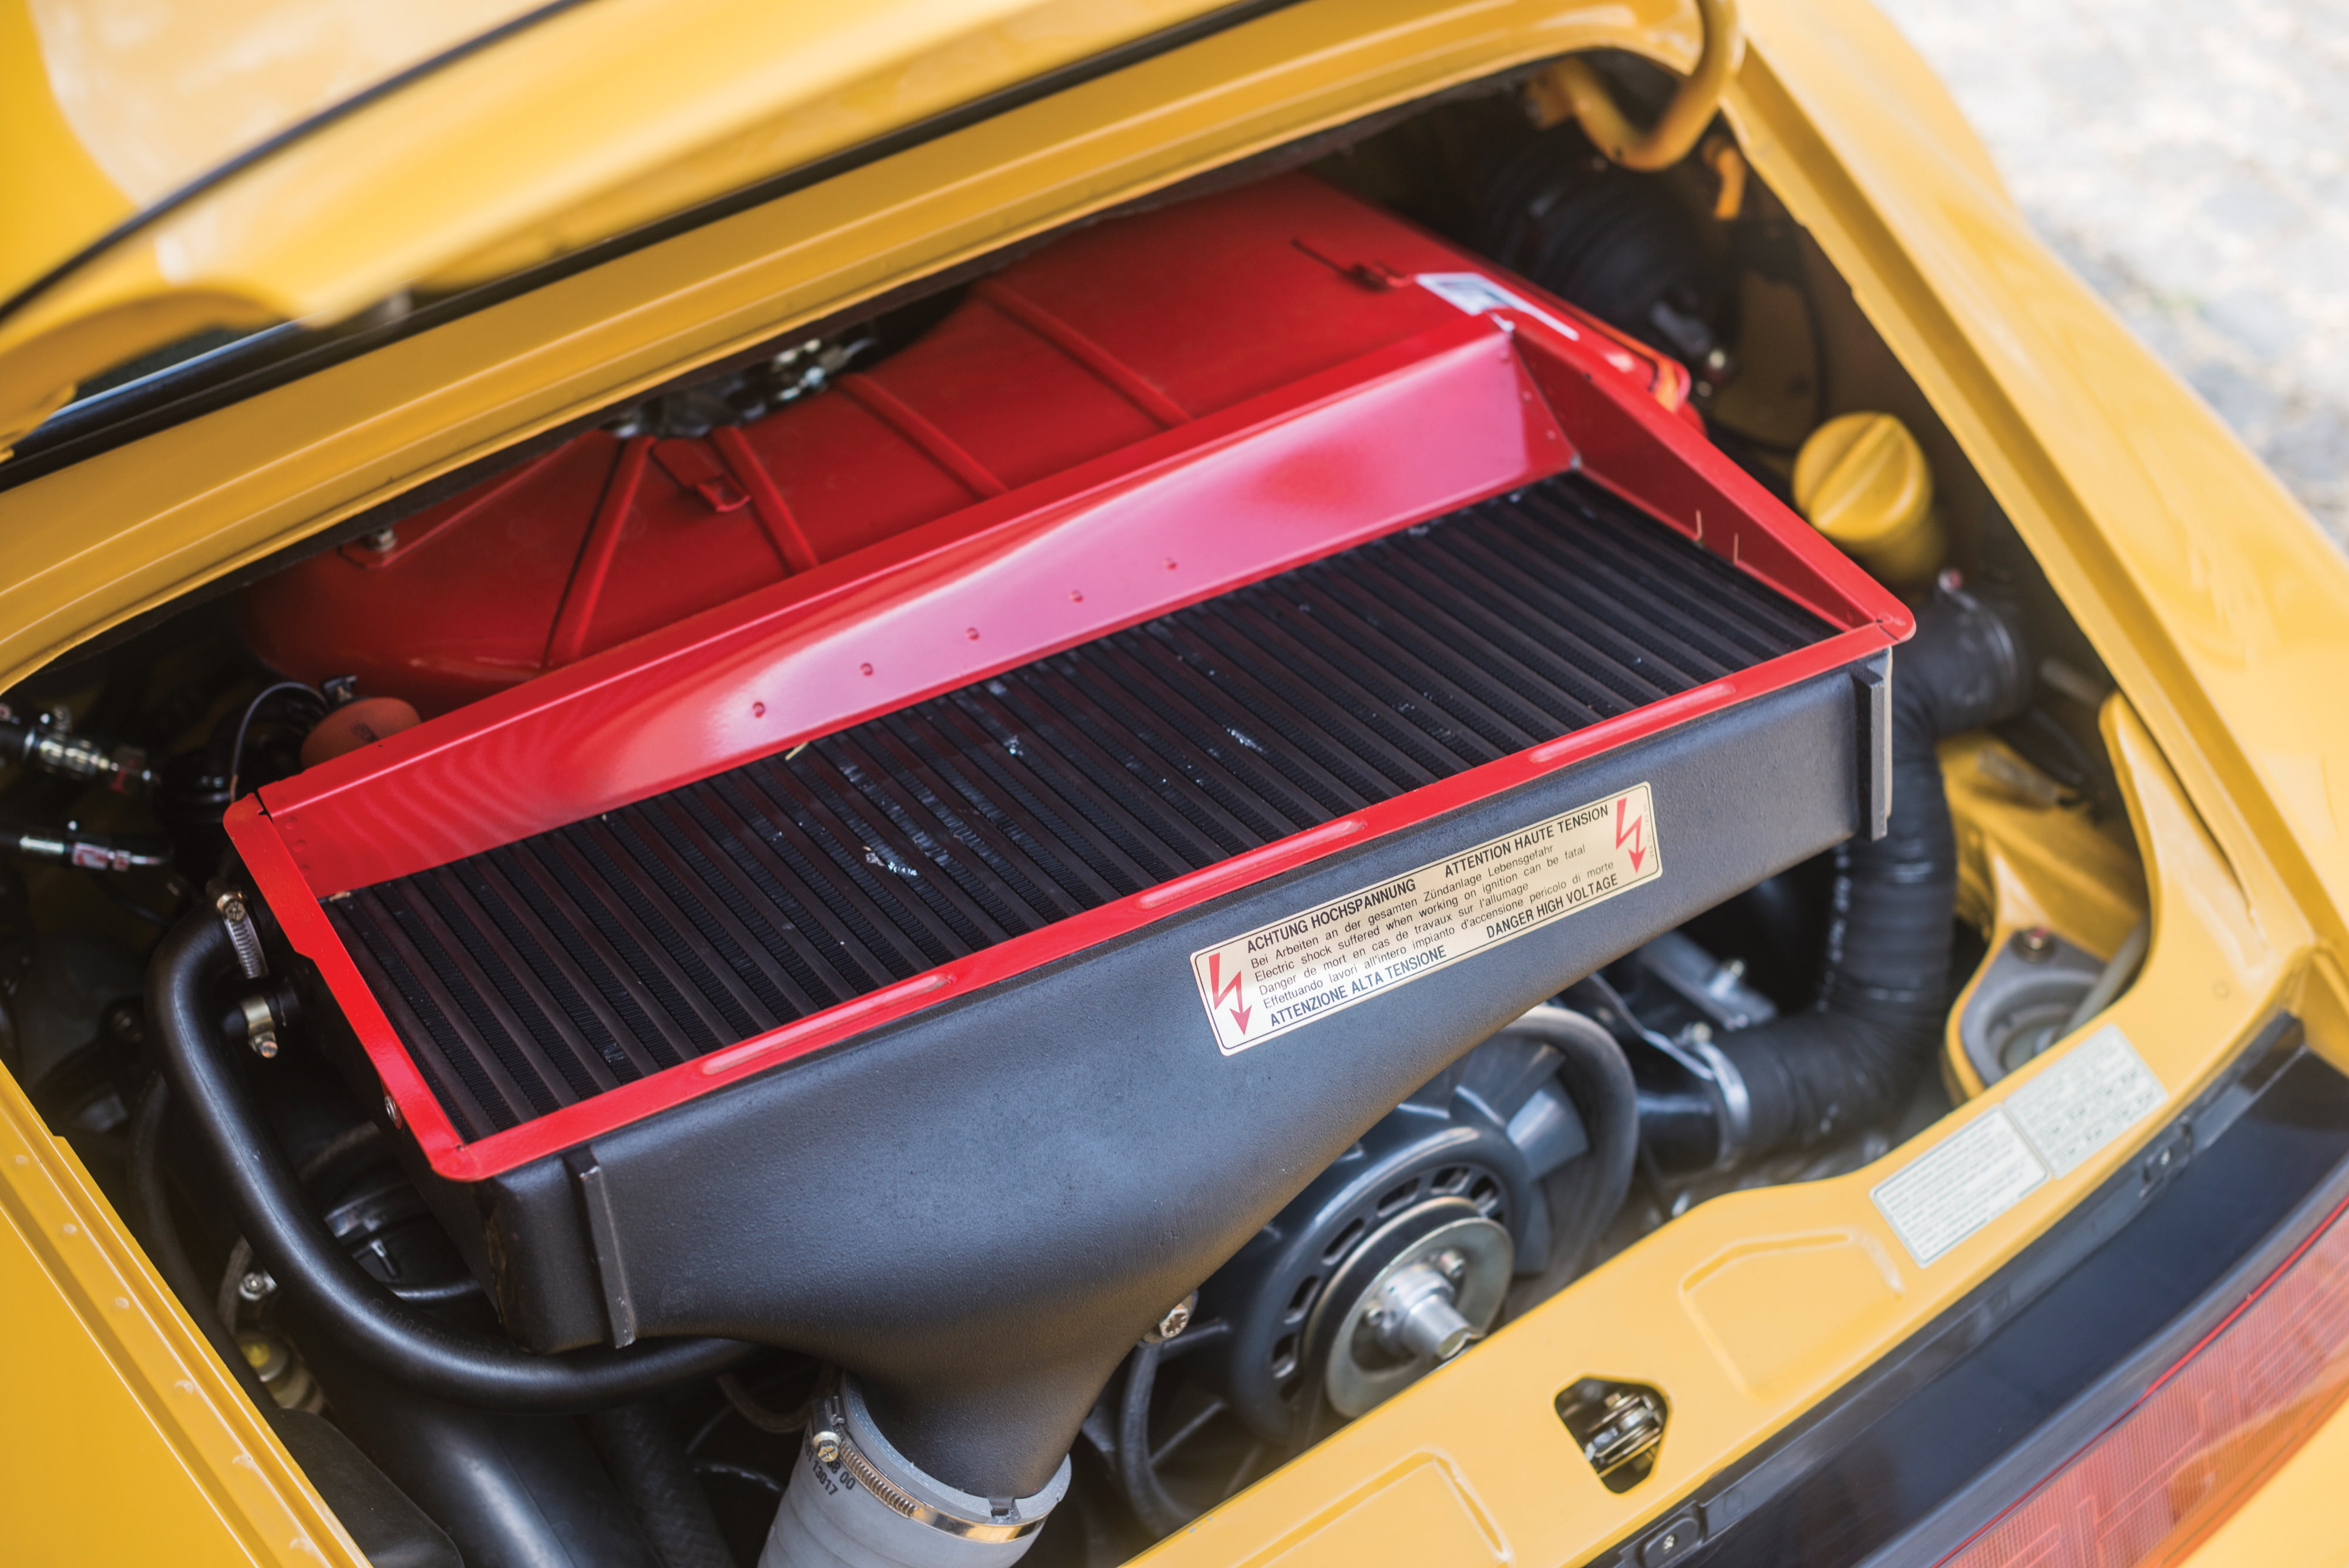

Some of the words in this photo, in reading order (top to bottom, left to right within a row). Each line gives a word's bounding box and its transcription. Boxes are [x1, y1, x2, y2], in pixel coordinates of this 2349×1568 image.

[1446, 842, 1511, 877] ATTENTION
[1515, 825, 1554, 850] HAUTE
[1557, 805, 1607, 833] TENSION
[1248, 920, 1308, 953] ACHTUNG
[1311, 879, 1415, 928] HOCHSPANNUNG
[1251, 957, 1268, 968] Bei
[1276, 937, 1318, 960] Arbeiten
[1325, 930, 1338, 940] an
[1345, 921, 1360, 932] der
[1368, 899, 1417, 926] gesamten
[1423, 874, 1481, 901] Zündanlage
[1488, 846, 1553, 876] Lebensgefahr
[1255, 961, 1294, 981] Electric
[1301, 946, 1332, 964] shock
[1338, 926, 1379, 949] suffered
[1386, 915, 1412, 930] when
[1419, 898, 1458, 917] working
[1465, 890, 1476, 900] on
[1483, 874, 1517, 894] ignition
[1524, 864, 1541, 876] can
[1547, 857, 1558, 866] be
[1565, 844, 1585, 859] fatal
[1259, 975, 1295, 995] Danger
[1304, 968, 1316, 977] de
[1324, 954, 1347, 970] mort
[1353, 948, 1365, 958] en
[1372, 939, 1389, 951] cas
[1396, 931, 1408, 941] de
[1415, 914, 1452, 934] travaux
[1459, 905, 1473, 916] sur
[1480, 883, 1528, 908] l'allumage
[1264, 980, 1322, 1008] Effettuando
[1329, 966, 1357, 982] lavori
[1364, 947, 1406, 968] all'intero
[1413, 927, 1455, 949] impianto
[1461, 900, 1523, 929] d'accensione
[1530, 881, 1566, 904] pericolo
[1573, 874, 1580, 884] di
[1587, 862, 1613, 878] morte
[1486, 909, 1534, 938] DANGER
[1537, 896, 1563, 917] HIGH
[1566, 874, 1618, 904] VOLTAGE
[1271, 985, 1348, 1027] ATTENZIONE
[1352, 972, 1384, 994] ALTA
[1385, 945, 1446, 978] TENSIONE
[813, 1461, 838, 1495] 13017
[840, 1471, 856, 1490] 00
